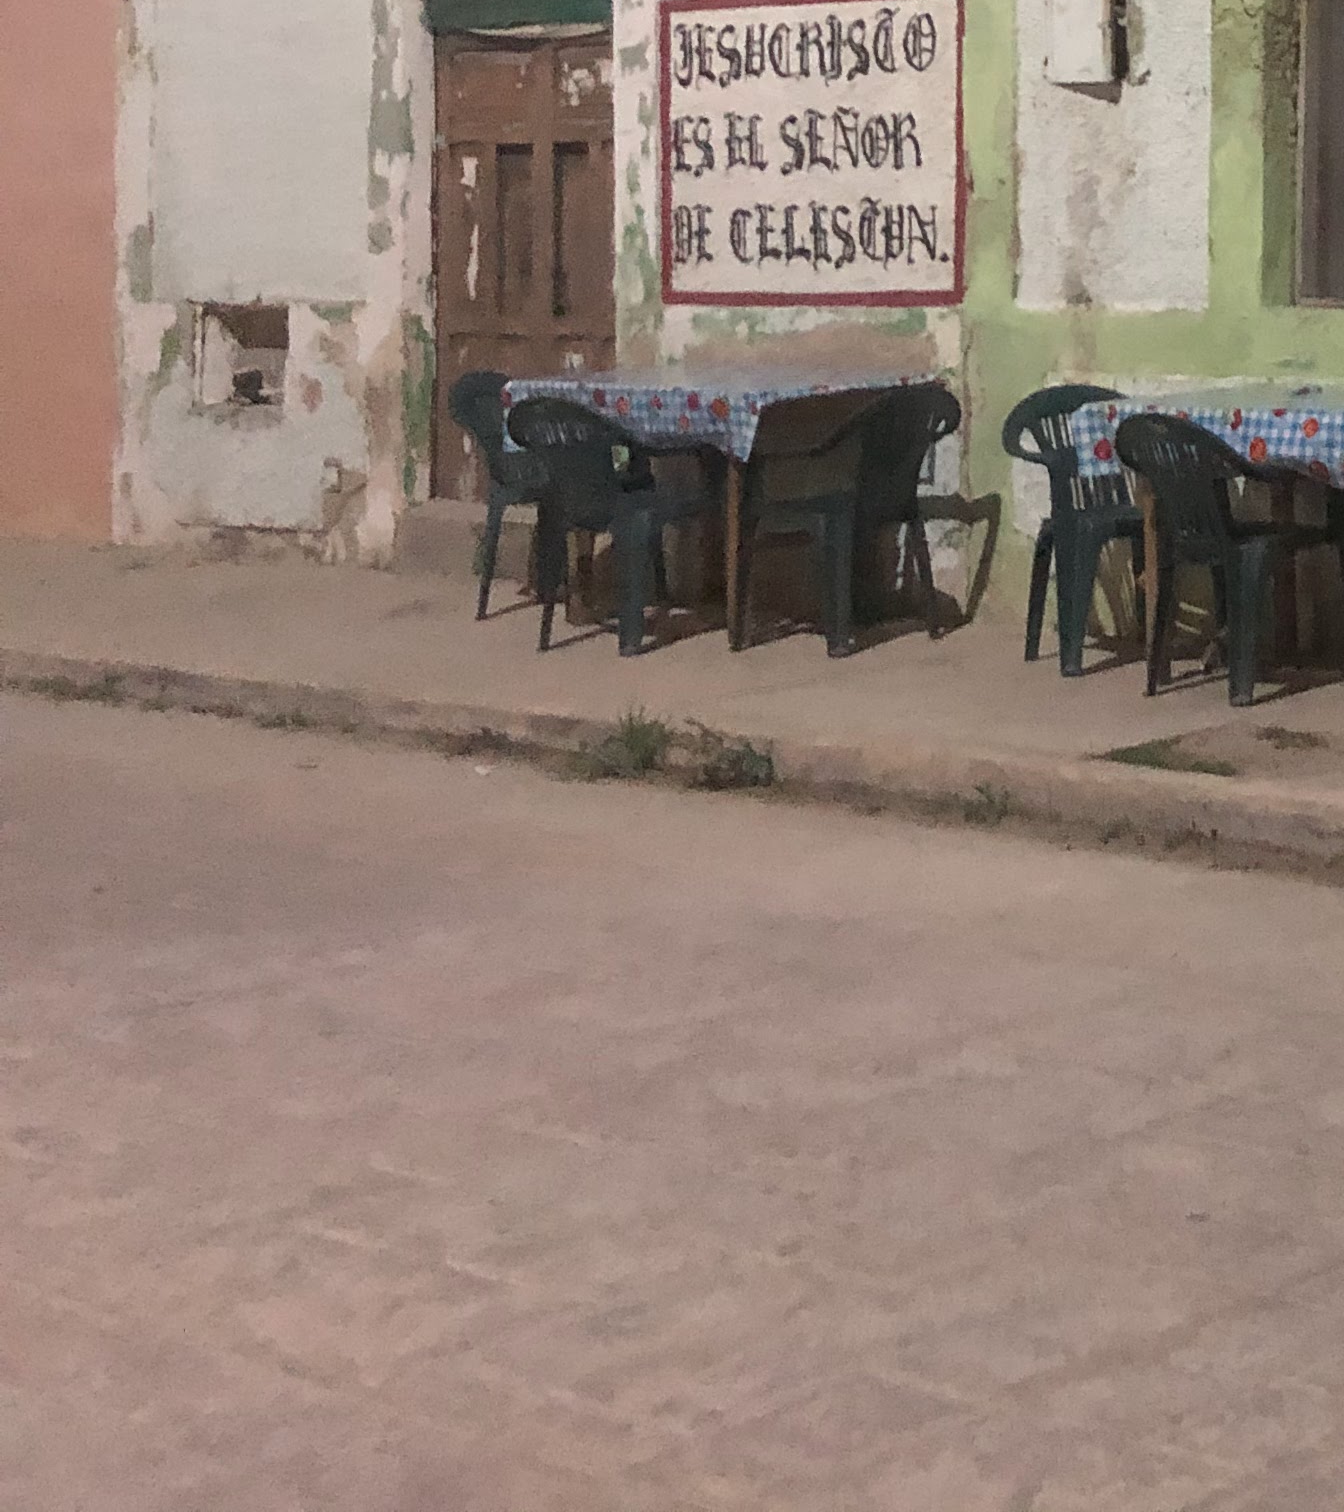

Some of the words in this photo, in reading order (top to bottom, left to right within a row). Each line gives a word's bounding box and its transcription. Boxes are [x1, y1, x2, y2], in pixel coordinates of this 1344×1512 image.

[673, 6, 938, 88] JESUCRISTO
[672, 114, 715, 177] ES
[724, 110, 768, 174] EL
[779, 104, 923, 176] SEÑOR
[672, 203, 714, 266] DE
